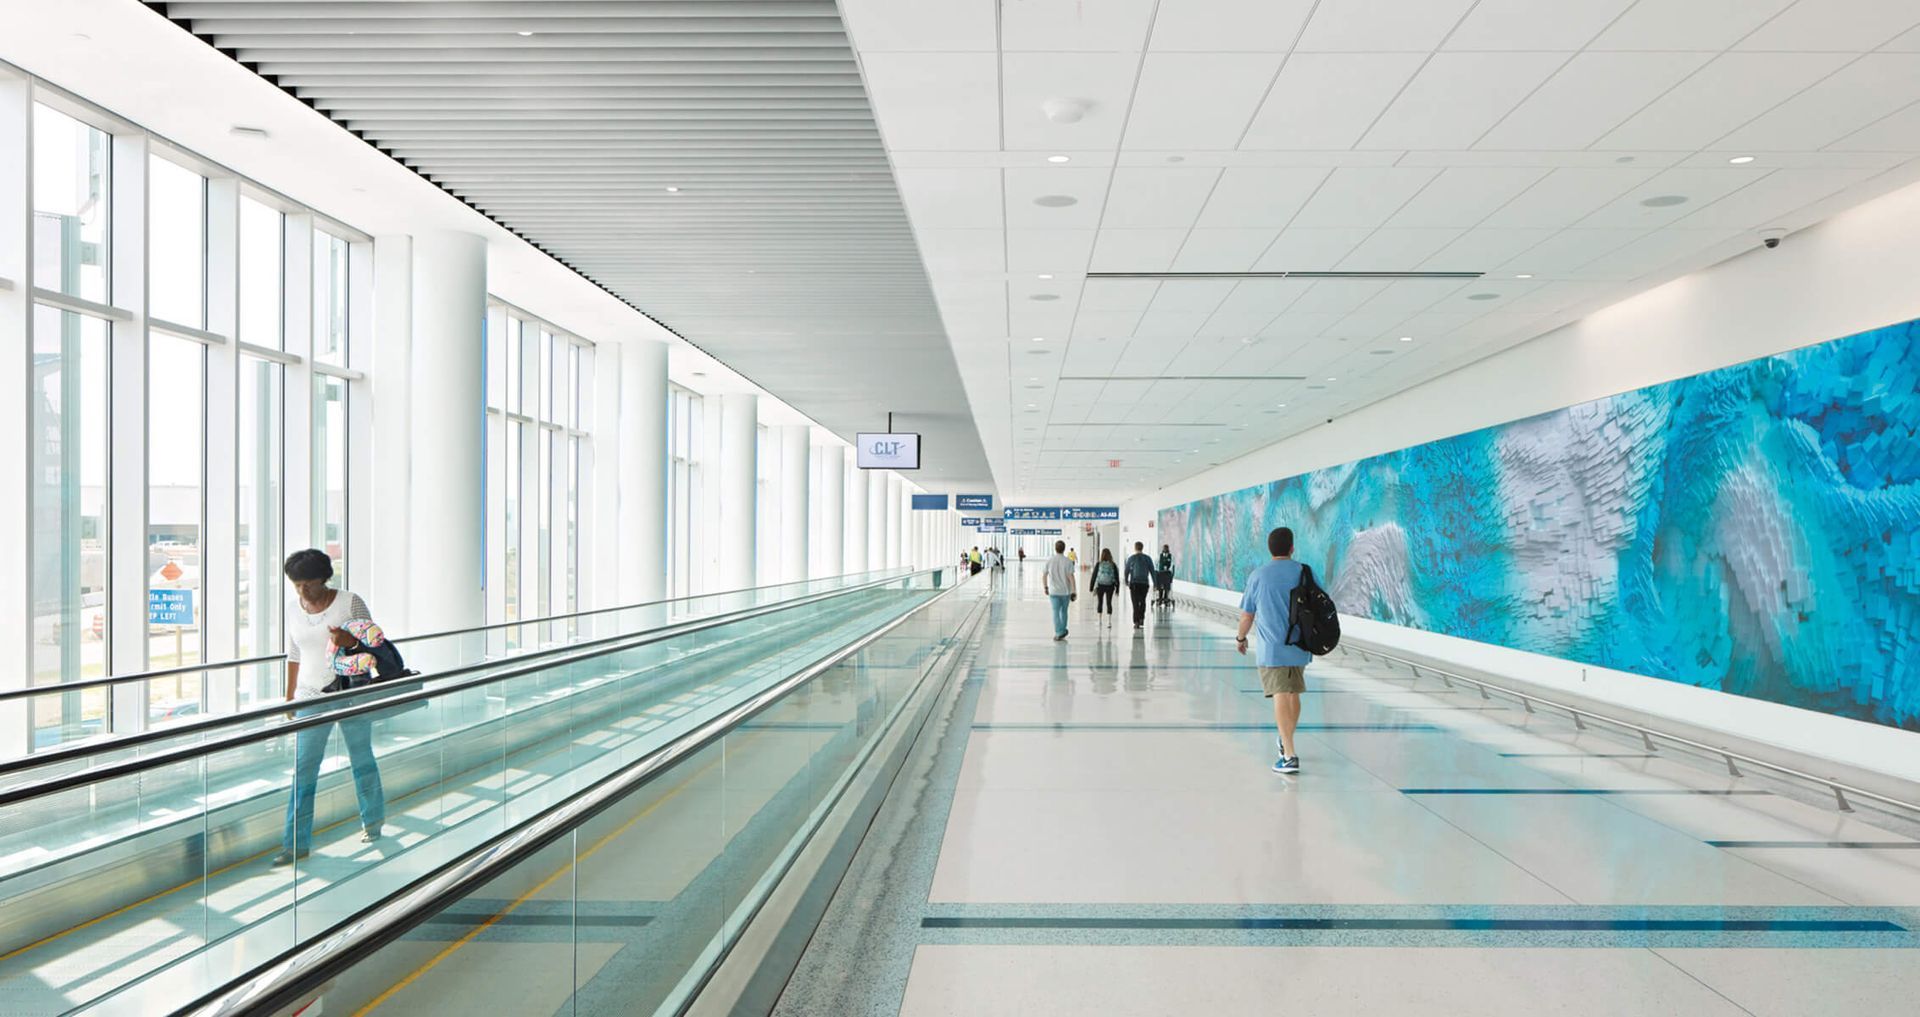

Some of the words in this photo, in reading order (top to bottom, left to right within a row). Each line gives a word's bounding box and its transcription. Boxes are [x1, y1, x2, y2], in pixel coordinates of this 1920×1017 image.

[875, 441, 900, 455] CLT
[162, 593, 183, 601] Buses
[170, 602, 186, 612] Only
[160, 612, 177, 620] LEFT
